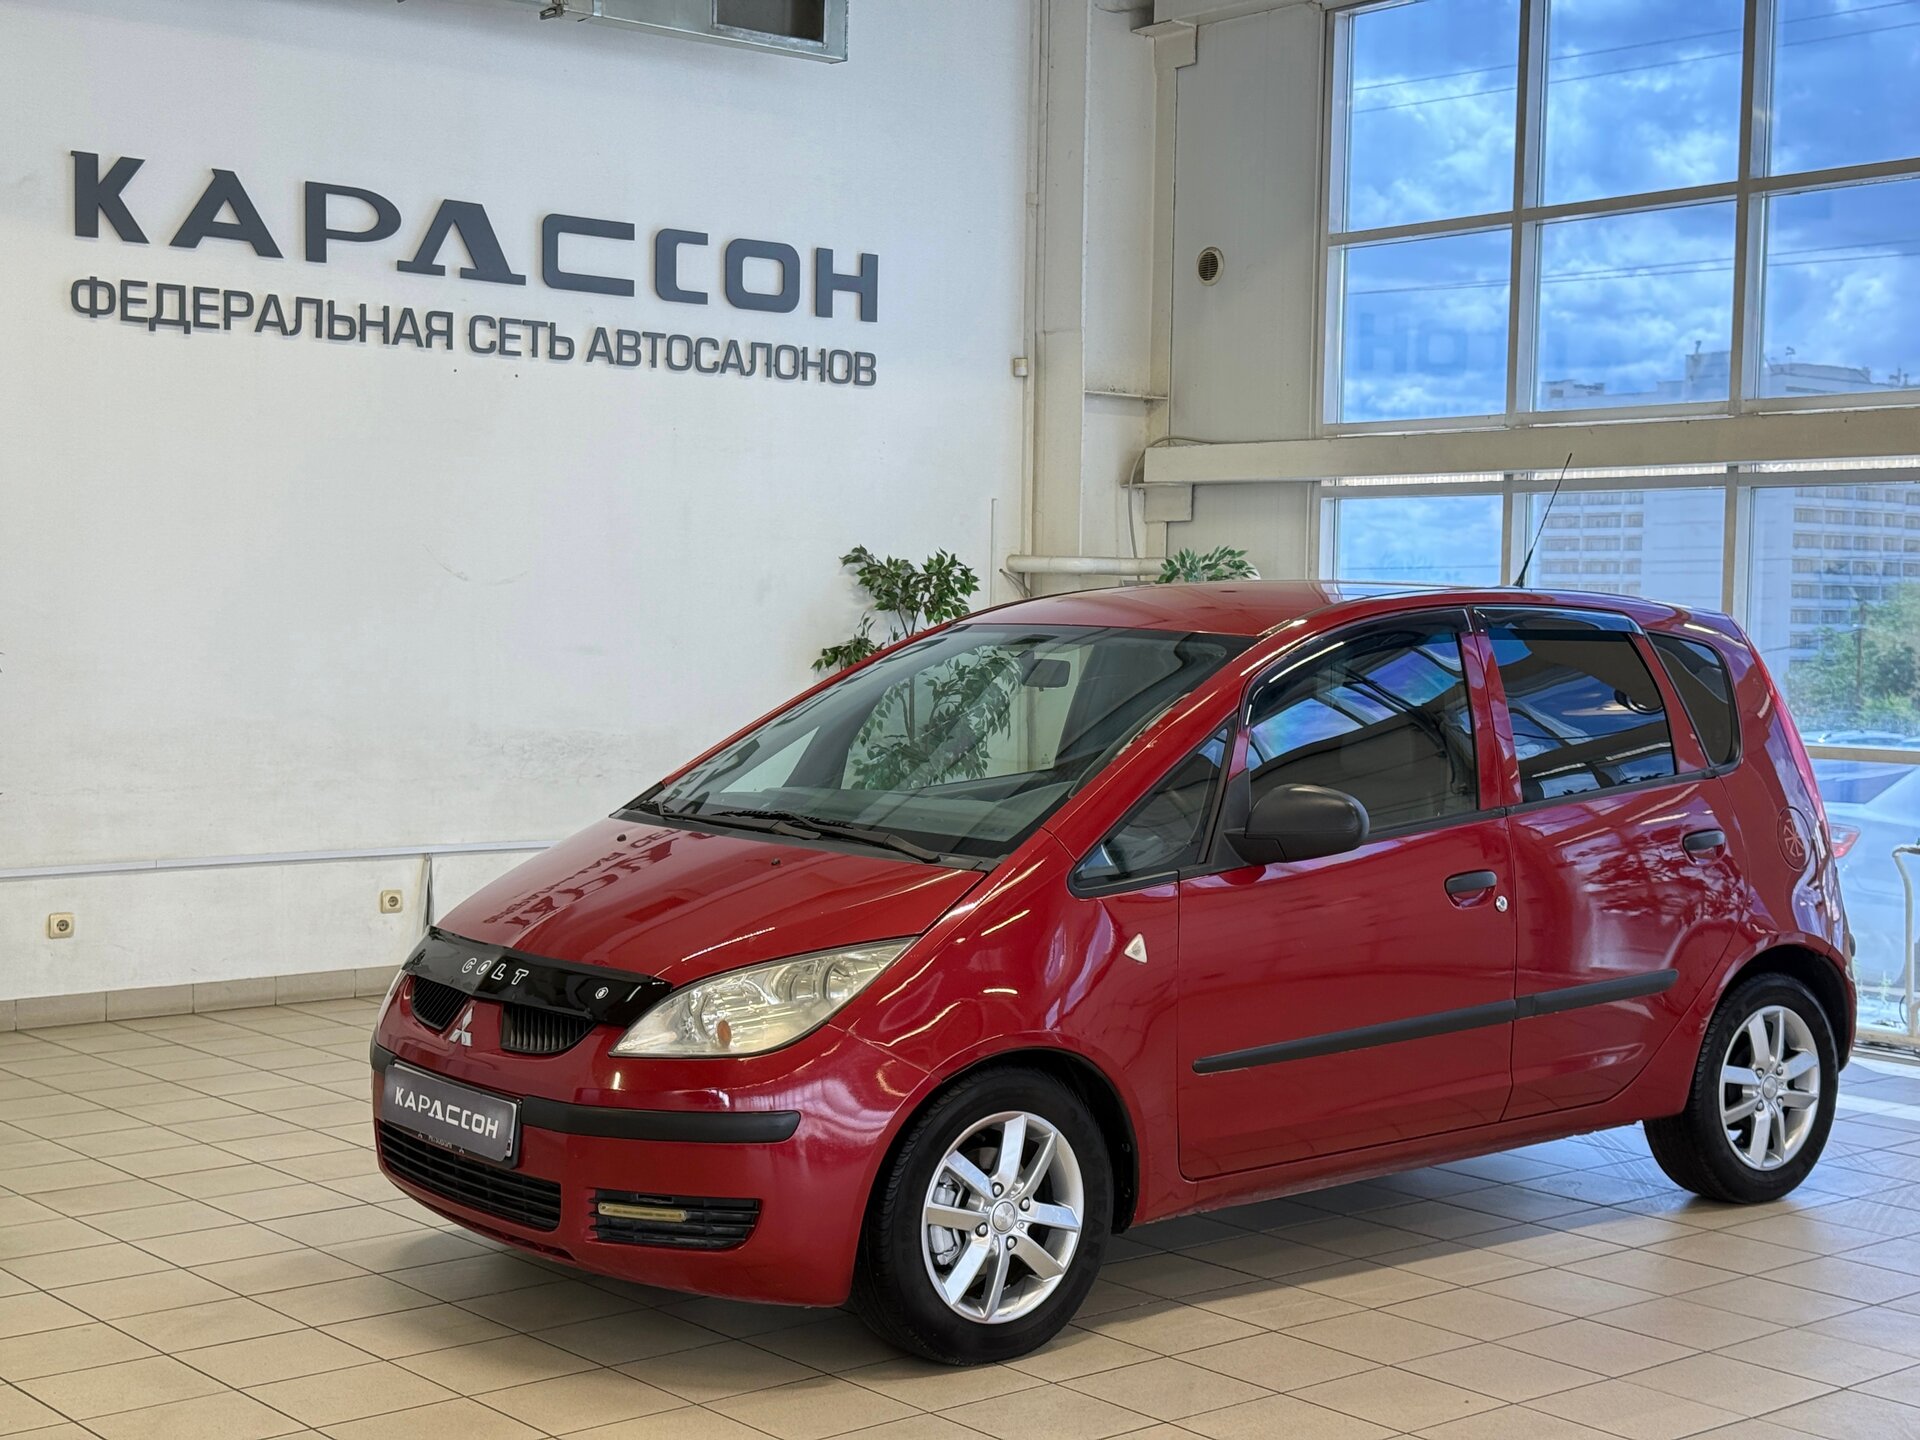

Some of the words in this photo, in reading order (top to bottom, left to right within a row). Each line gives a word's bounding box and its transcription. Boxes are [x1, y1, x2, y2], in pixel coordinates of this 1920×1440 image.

[71, 150, 879, 322] КАРАССОН
[71, 276, 454, 350] ФЕДЕРАЛЬНАЯ
[469, 314, 575, 361] СЕТЬ
[586, 326, 877, 386] АВТОСАЛОНОВ
[461, 957, 530, 986] COLT
[394, 1086, 499, 1140] КАРАССОН
